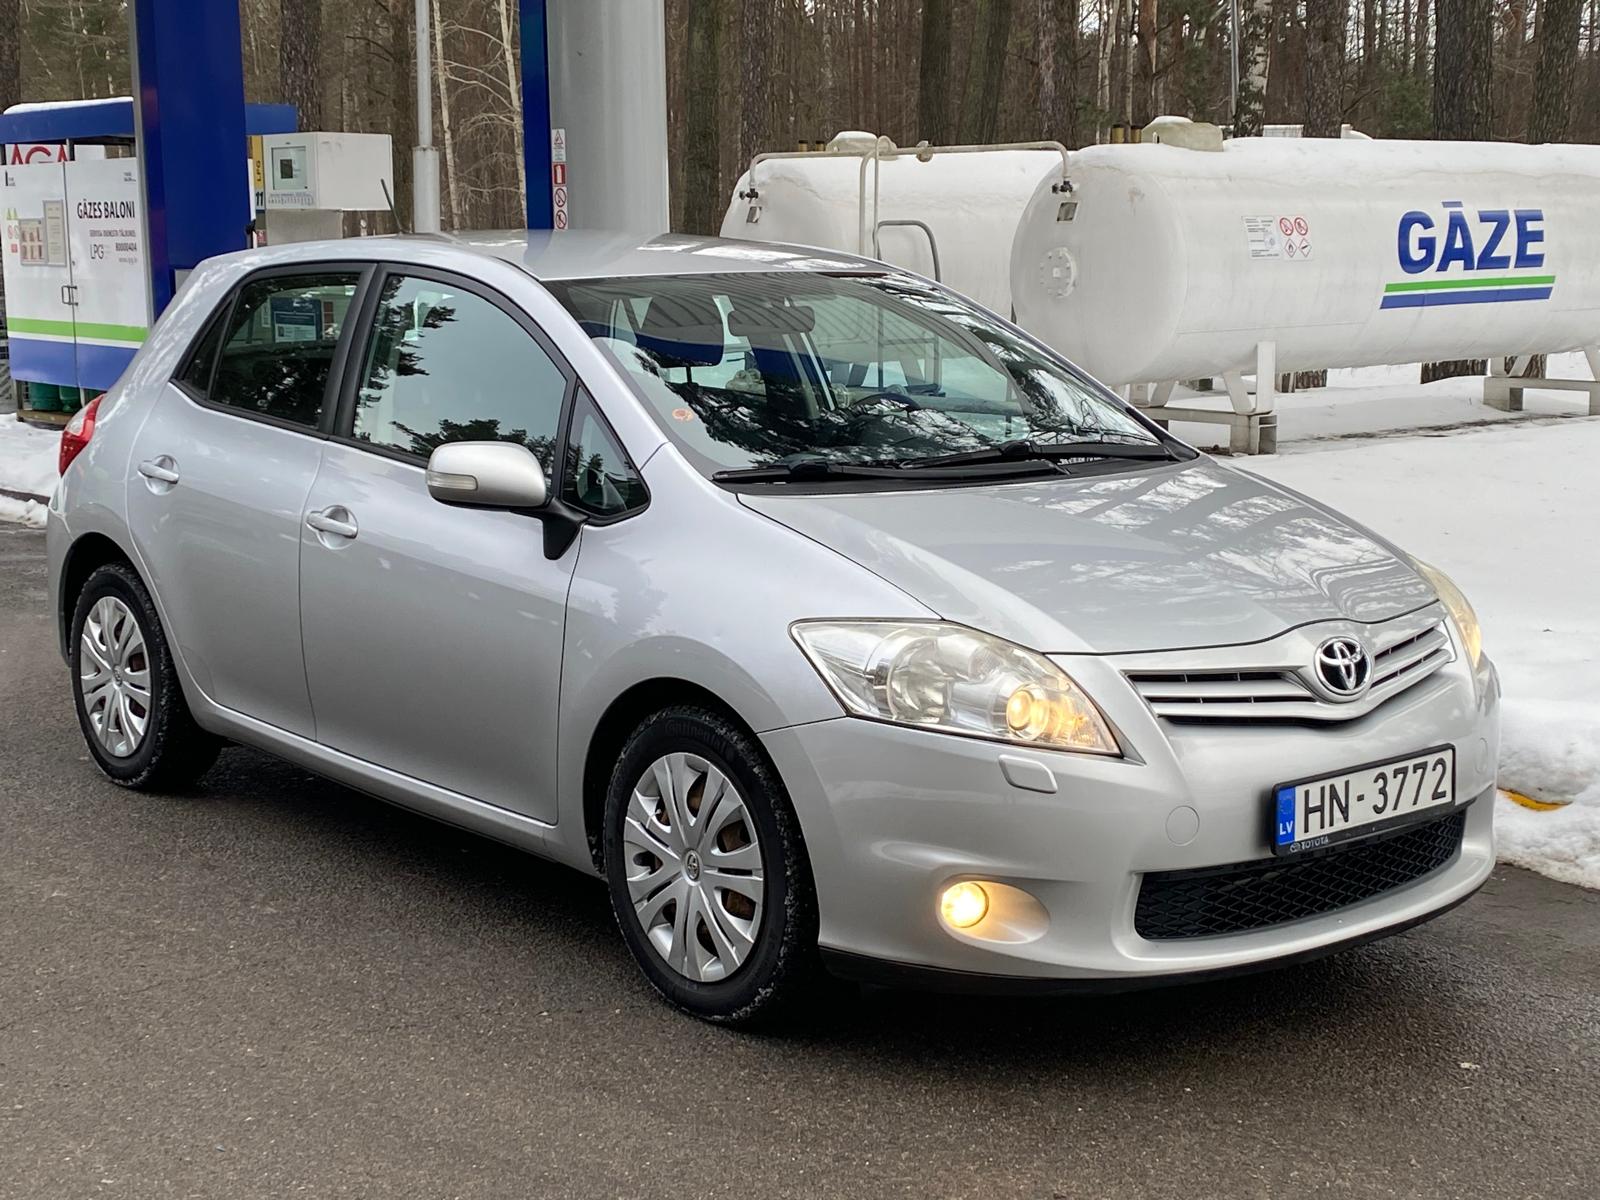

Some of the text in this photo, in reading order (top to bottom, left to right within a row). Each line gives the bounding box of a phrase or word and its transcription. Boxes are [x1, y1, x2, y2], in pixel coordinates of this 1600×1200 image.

[256, 192, 263, 206] 11
[104, 201, 135, 218] BALONI
[1398, 201, 1545, 274] GĀZE
[1303, 757, 1447, 834] HN-3772
[1279, 820, 1294, 836] LV
[1301, 836, 1329, 850] TOYOTA
